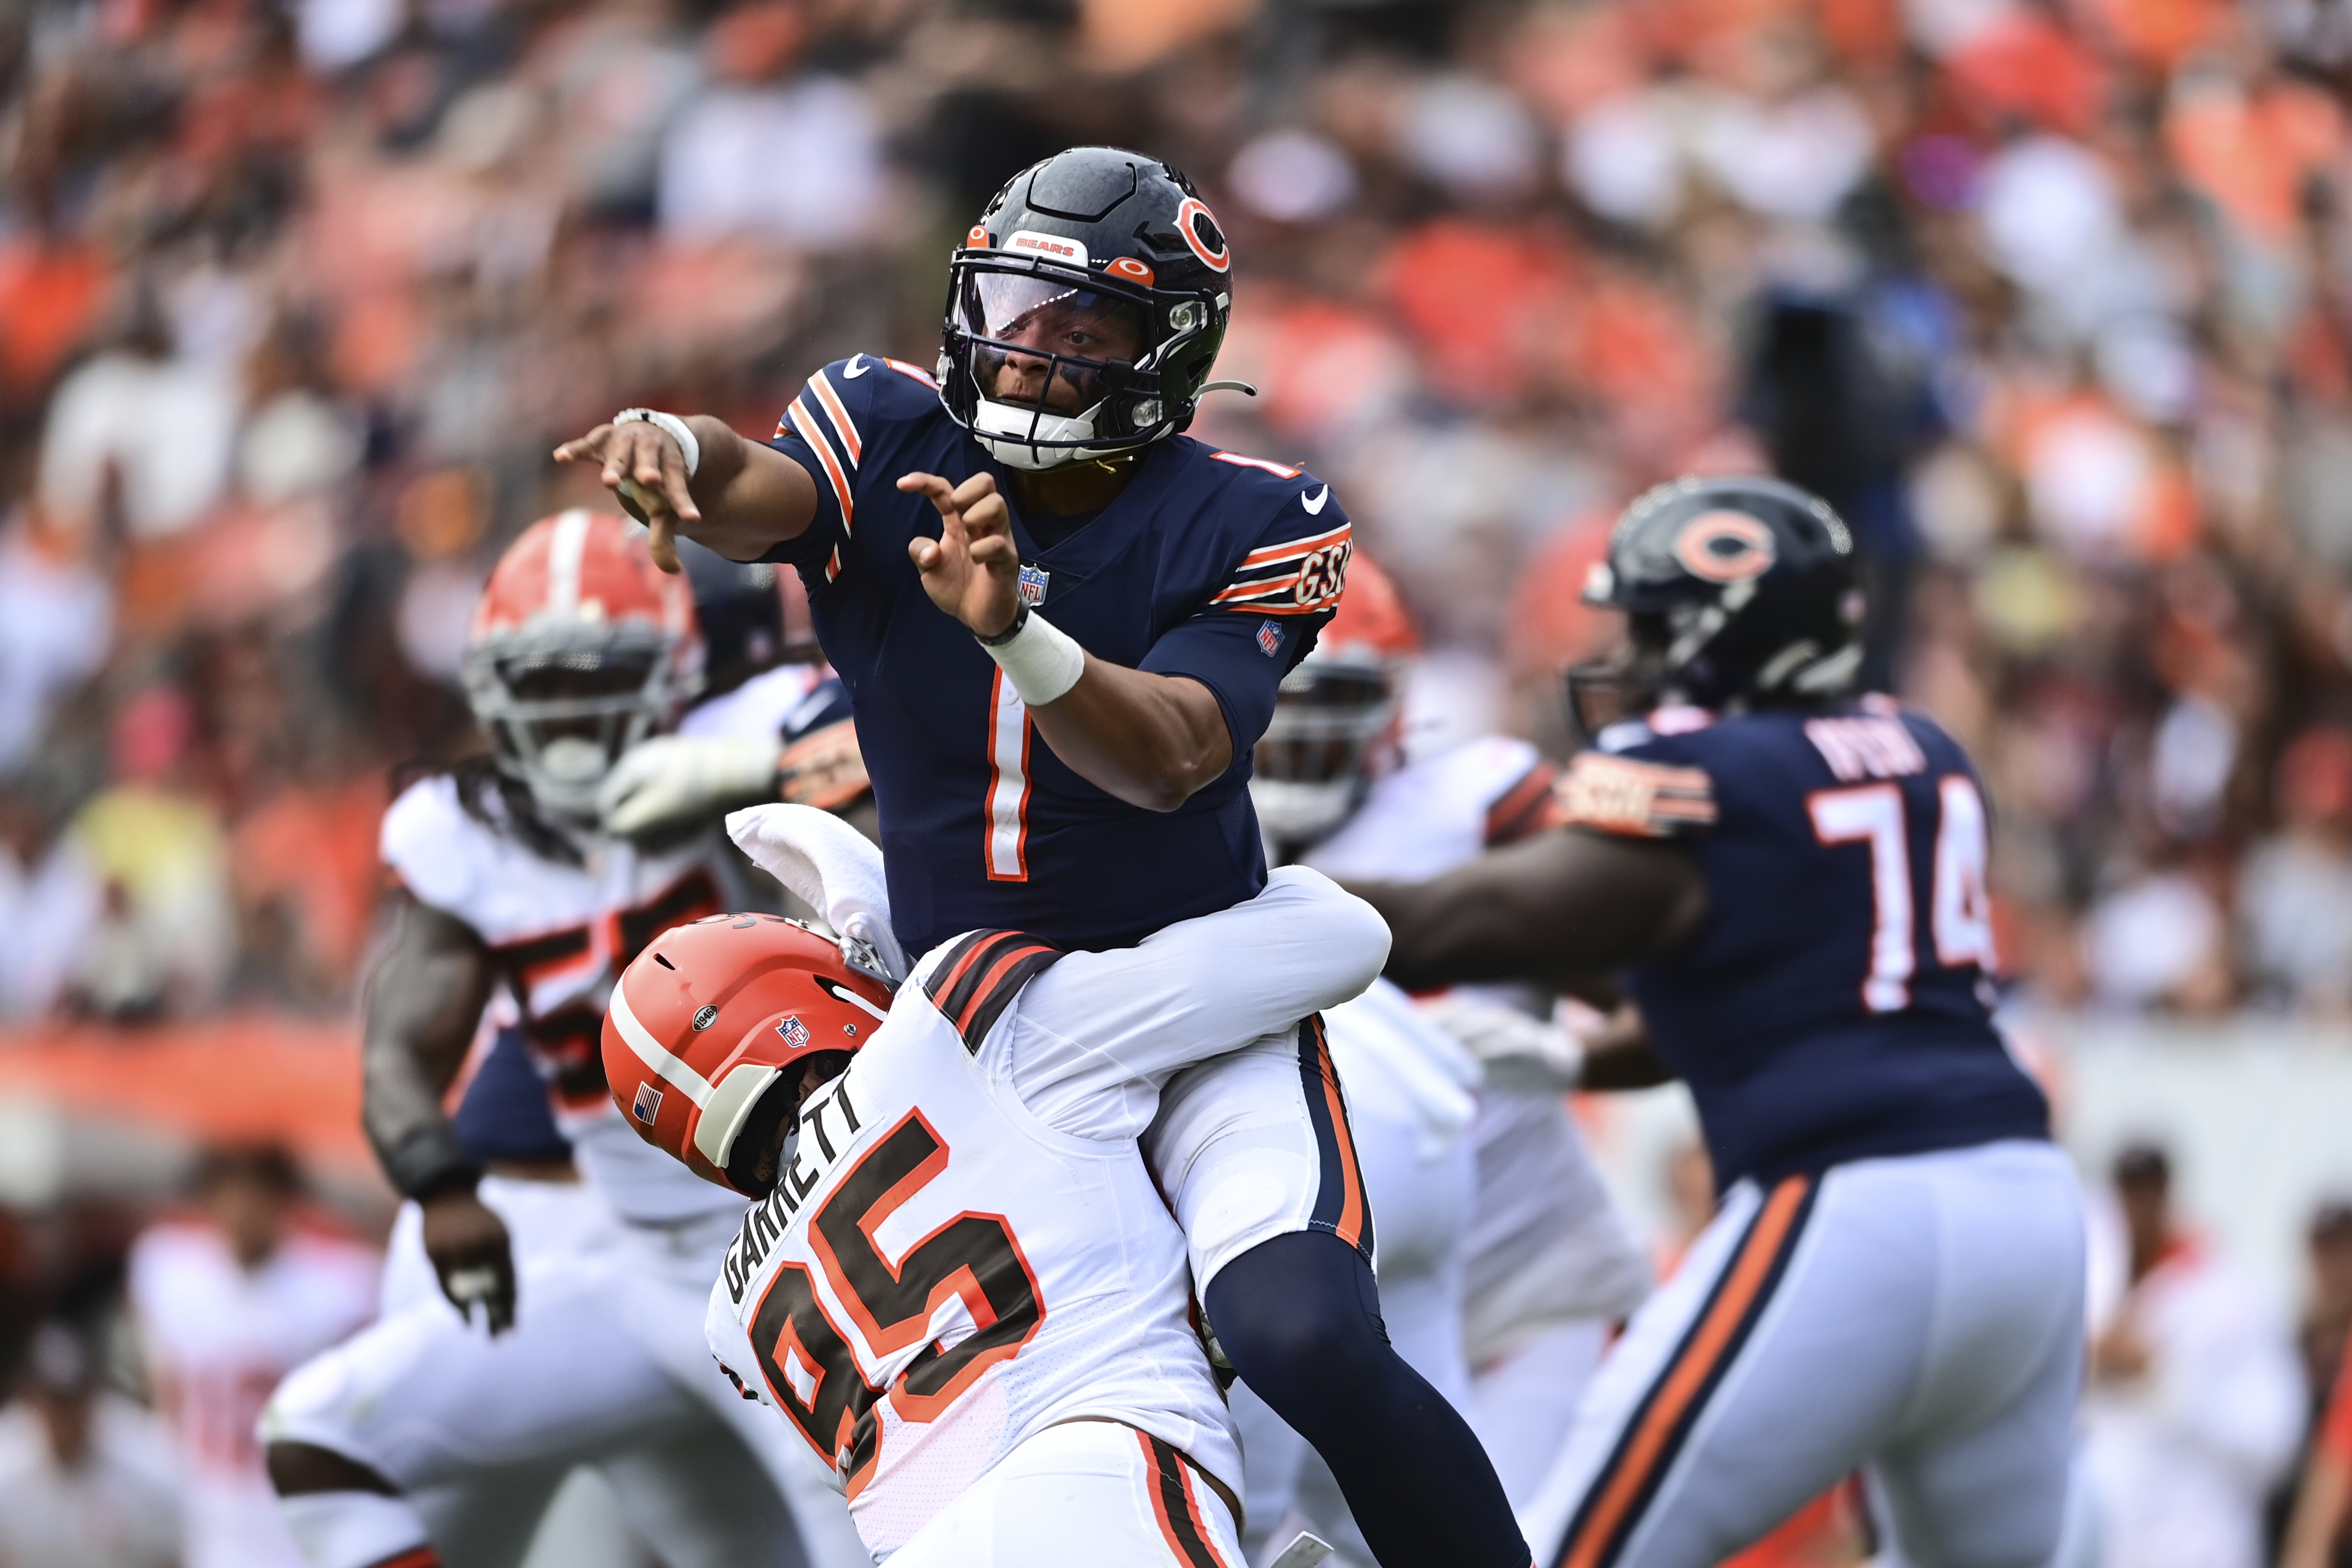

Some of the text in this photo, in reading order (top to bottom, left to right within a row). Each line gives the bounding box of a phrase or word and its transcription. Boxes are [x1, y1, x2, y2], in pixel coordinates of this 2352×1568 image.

[1016, 237, 1074, 257] BEARS
[1294, 536, 1354, 605] GSH
[1020, 582, 1041, 601] NFL
[1260, 628, 1277, 653] NFL
[984, 663, 1033, 882] 1
[1804, 773, 1999, 1015] 74
[696, 1008, 714, 1027] 1946
[786, 1027, 806, 1044] NFL
[747, 1105, 1047, 1506] 95
